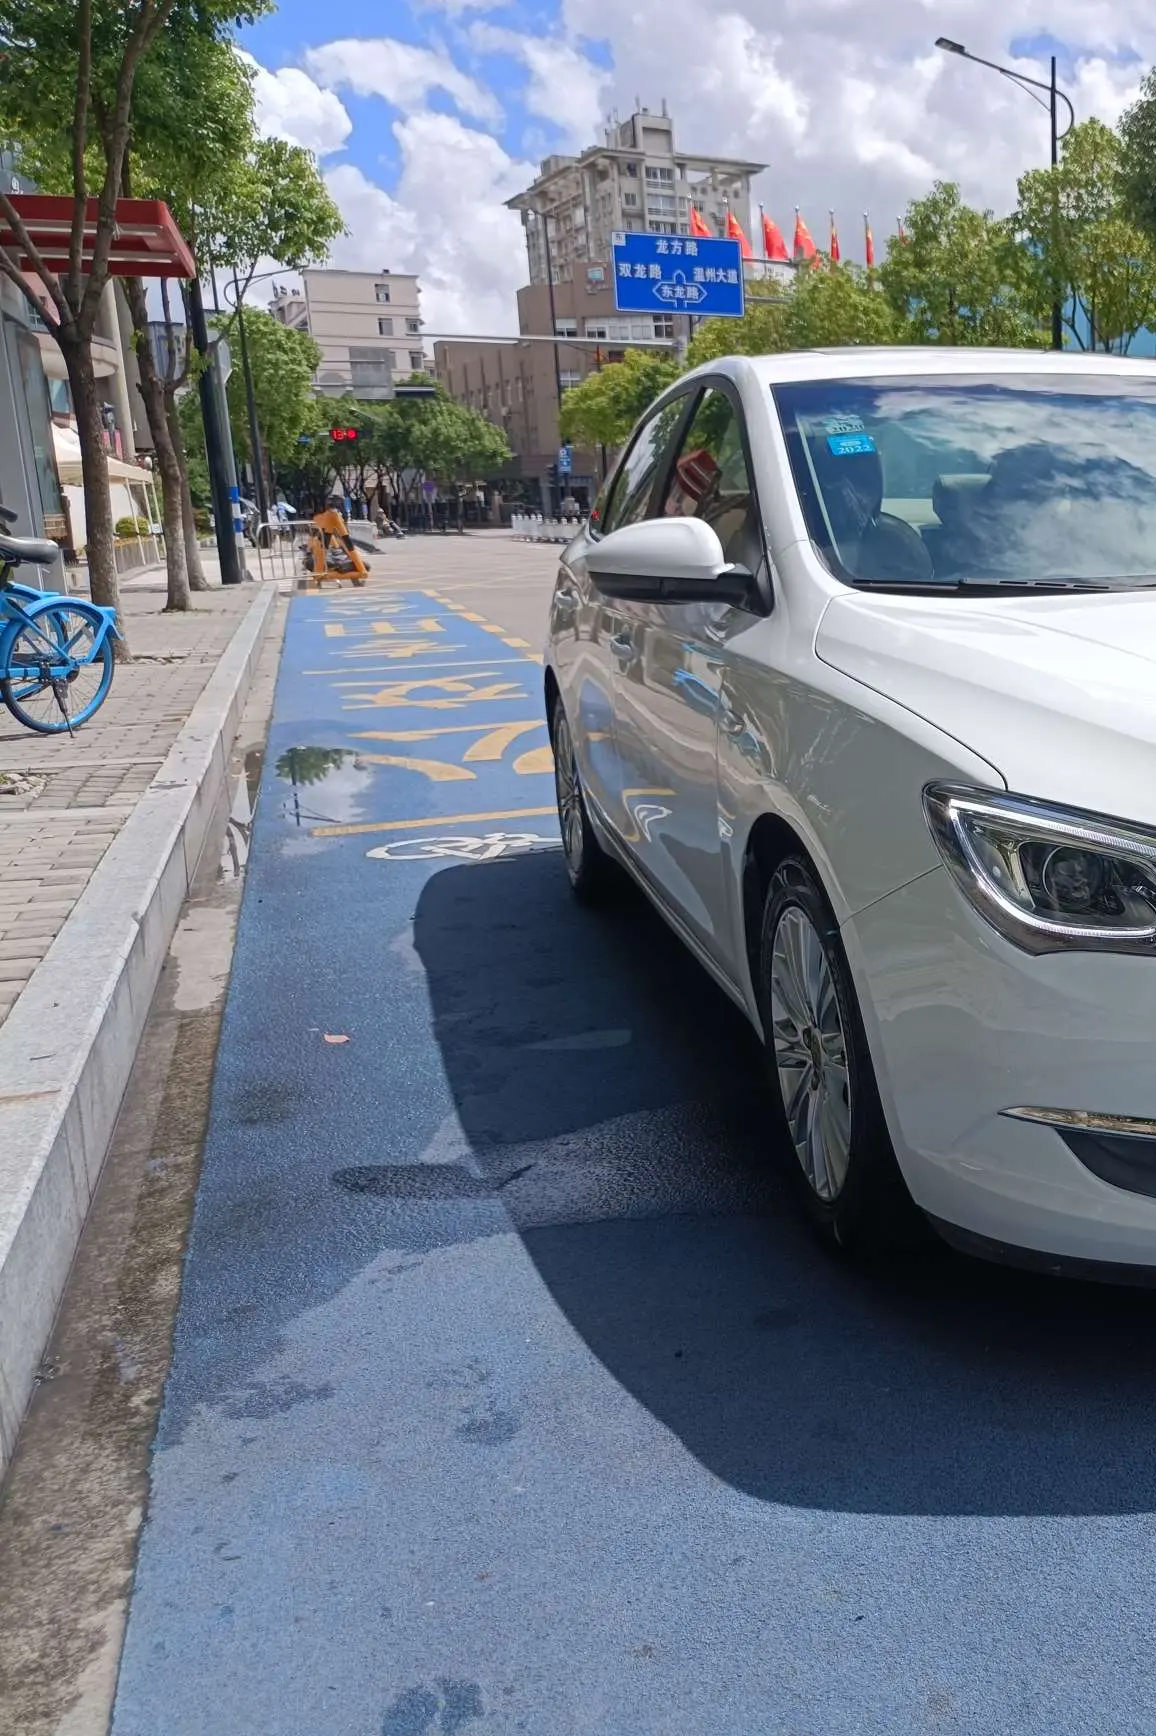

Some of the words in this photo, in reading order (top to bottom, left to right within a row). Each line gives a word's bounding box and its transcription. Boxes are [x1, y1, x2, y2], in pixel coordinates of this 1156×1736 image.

[656, 240, 698, 256] 龙方路
[618, 263, 662, 280] 双龙路
[693, 267, 738, 284] 温州大道
[661, 285, 699, 299] 东龙路
